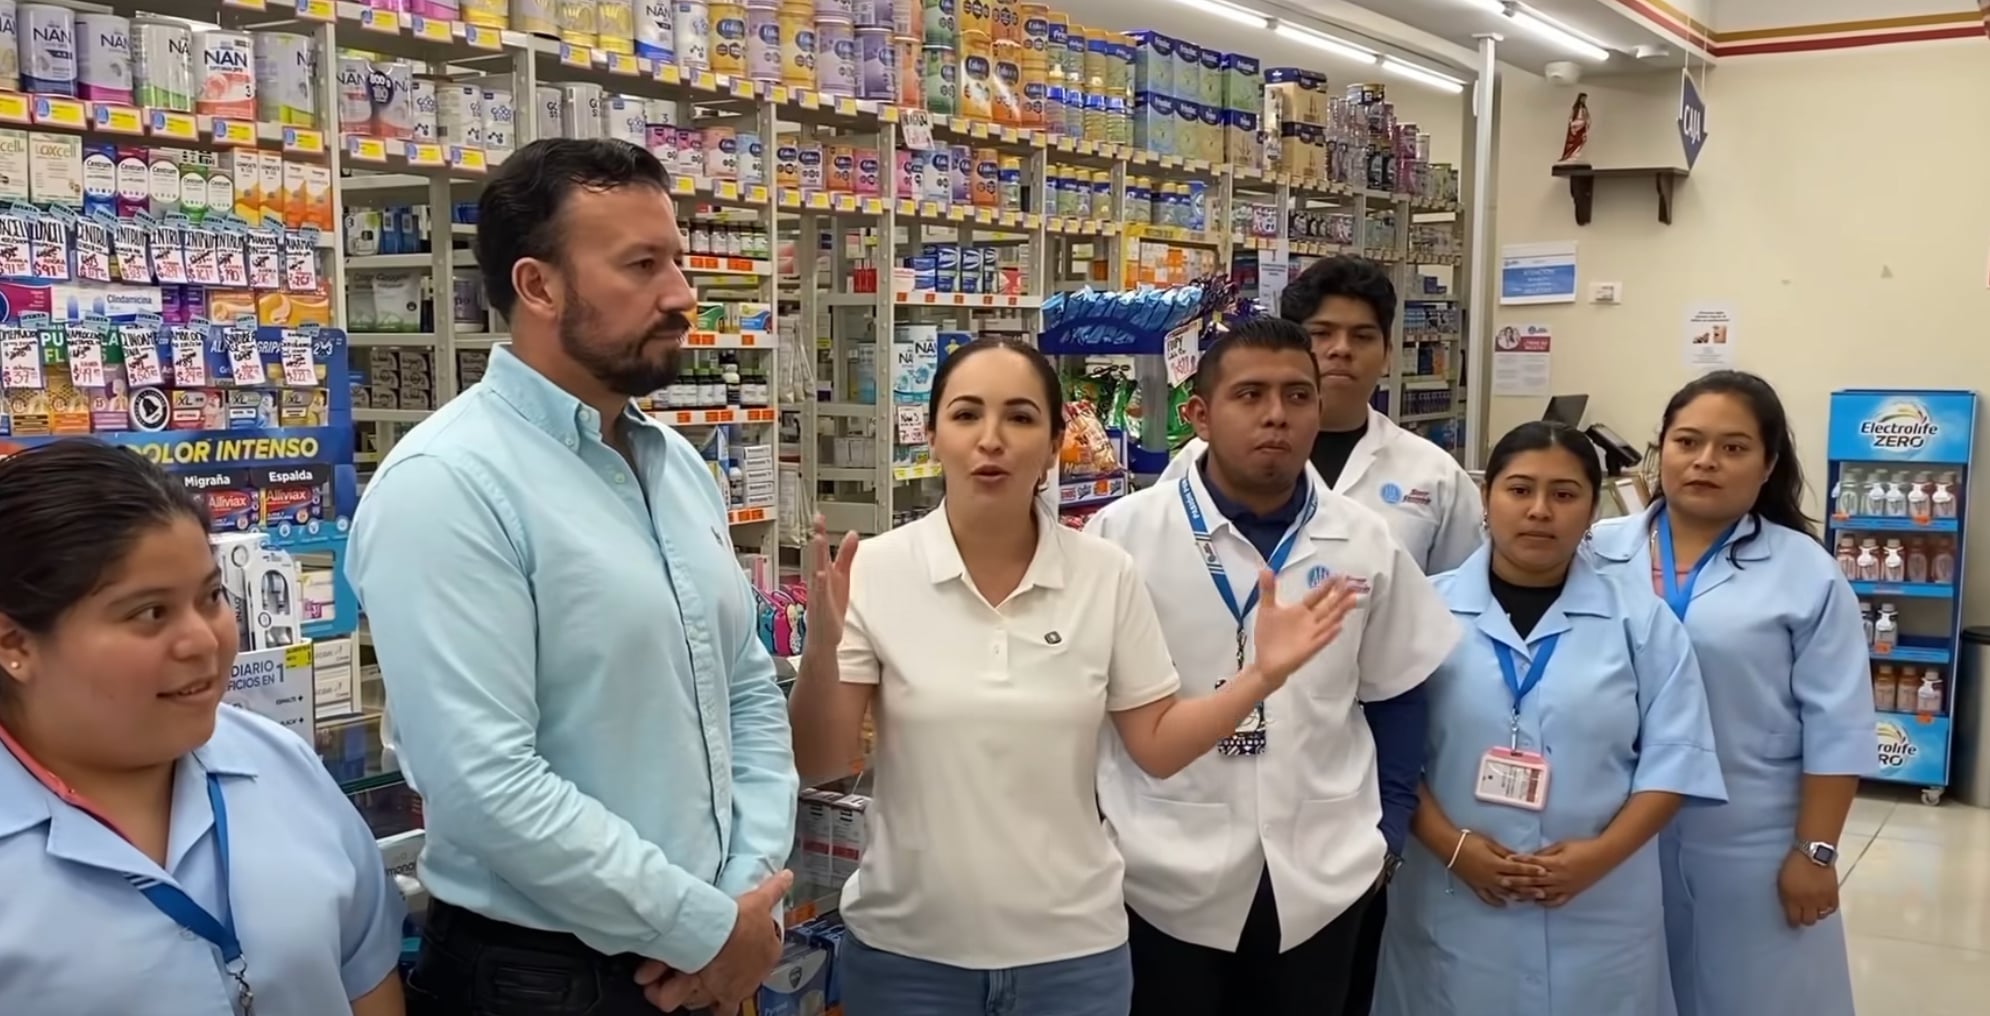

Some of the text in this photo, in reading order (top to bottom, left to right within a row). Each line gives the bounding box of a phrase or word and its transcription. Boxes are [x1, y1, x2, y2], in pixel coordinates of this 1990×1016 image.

[33, 27, 72, 43] NAN
[204, 50, 248, 67] NAN
[1684, 104, 1701, 145] CAJA
[86, 160, 112, 168] Centrum
[120, 163, 145, 171] Centrum
[152, 166, 177, 175] Centrum
[106, 293, 152, 305] Clindamicina
[1861, 421, 1938, 435] Electrolife
[1873, 435, 1925, 448] ZERO
[216, 436, 319, 462] INTENSO
[184, 469, 314, 489] Migraña Espalda
[208, 495, 248, 507] Alliviax
[265, 489, 307, 502] Alliviax
[231, 659, 274, 678] DIARIO
[227, 664, 284, 692] FICIOS EN 1
[1878, 742, 1917, 756] rolife
[1879, 754, 1903, 767] RO
